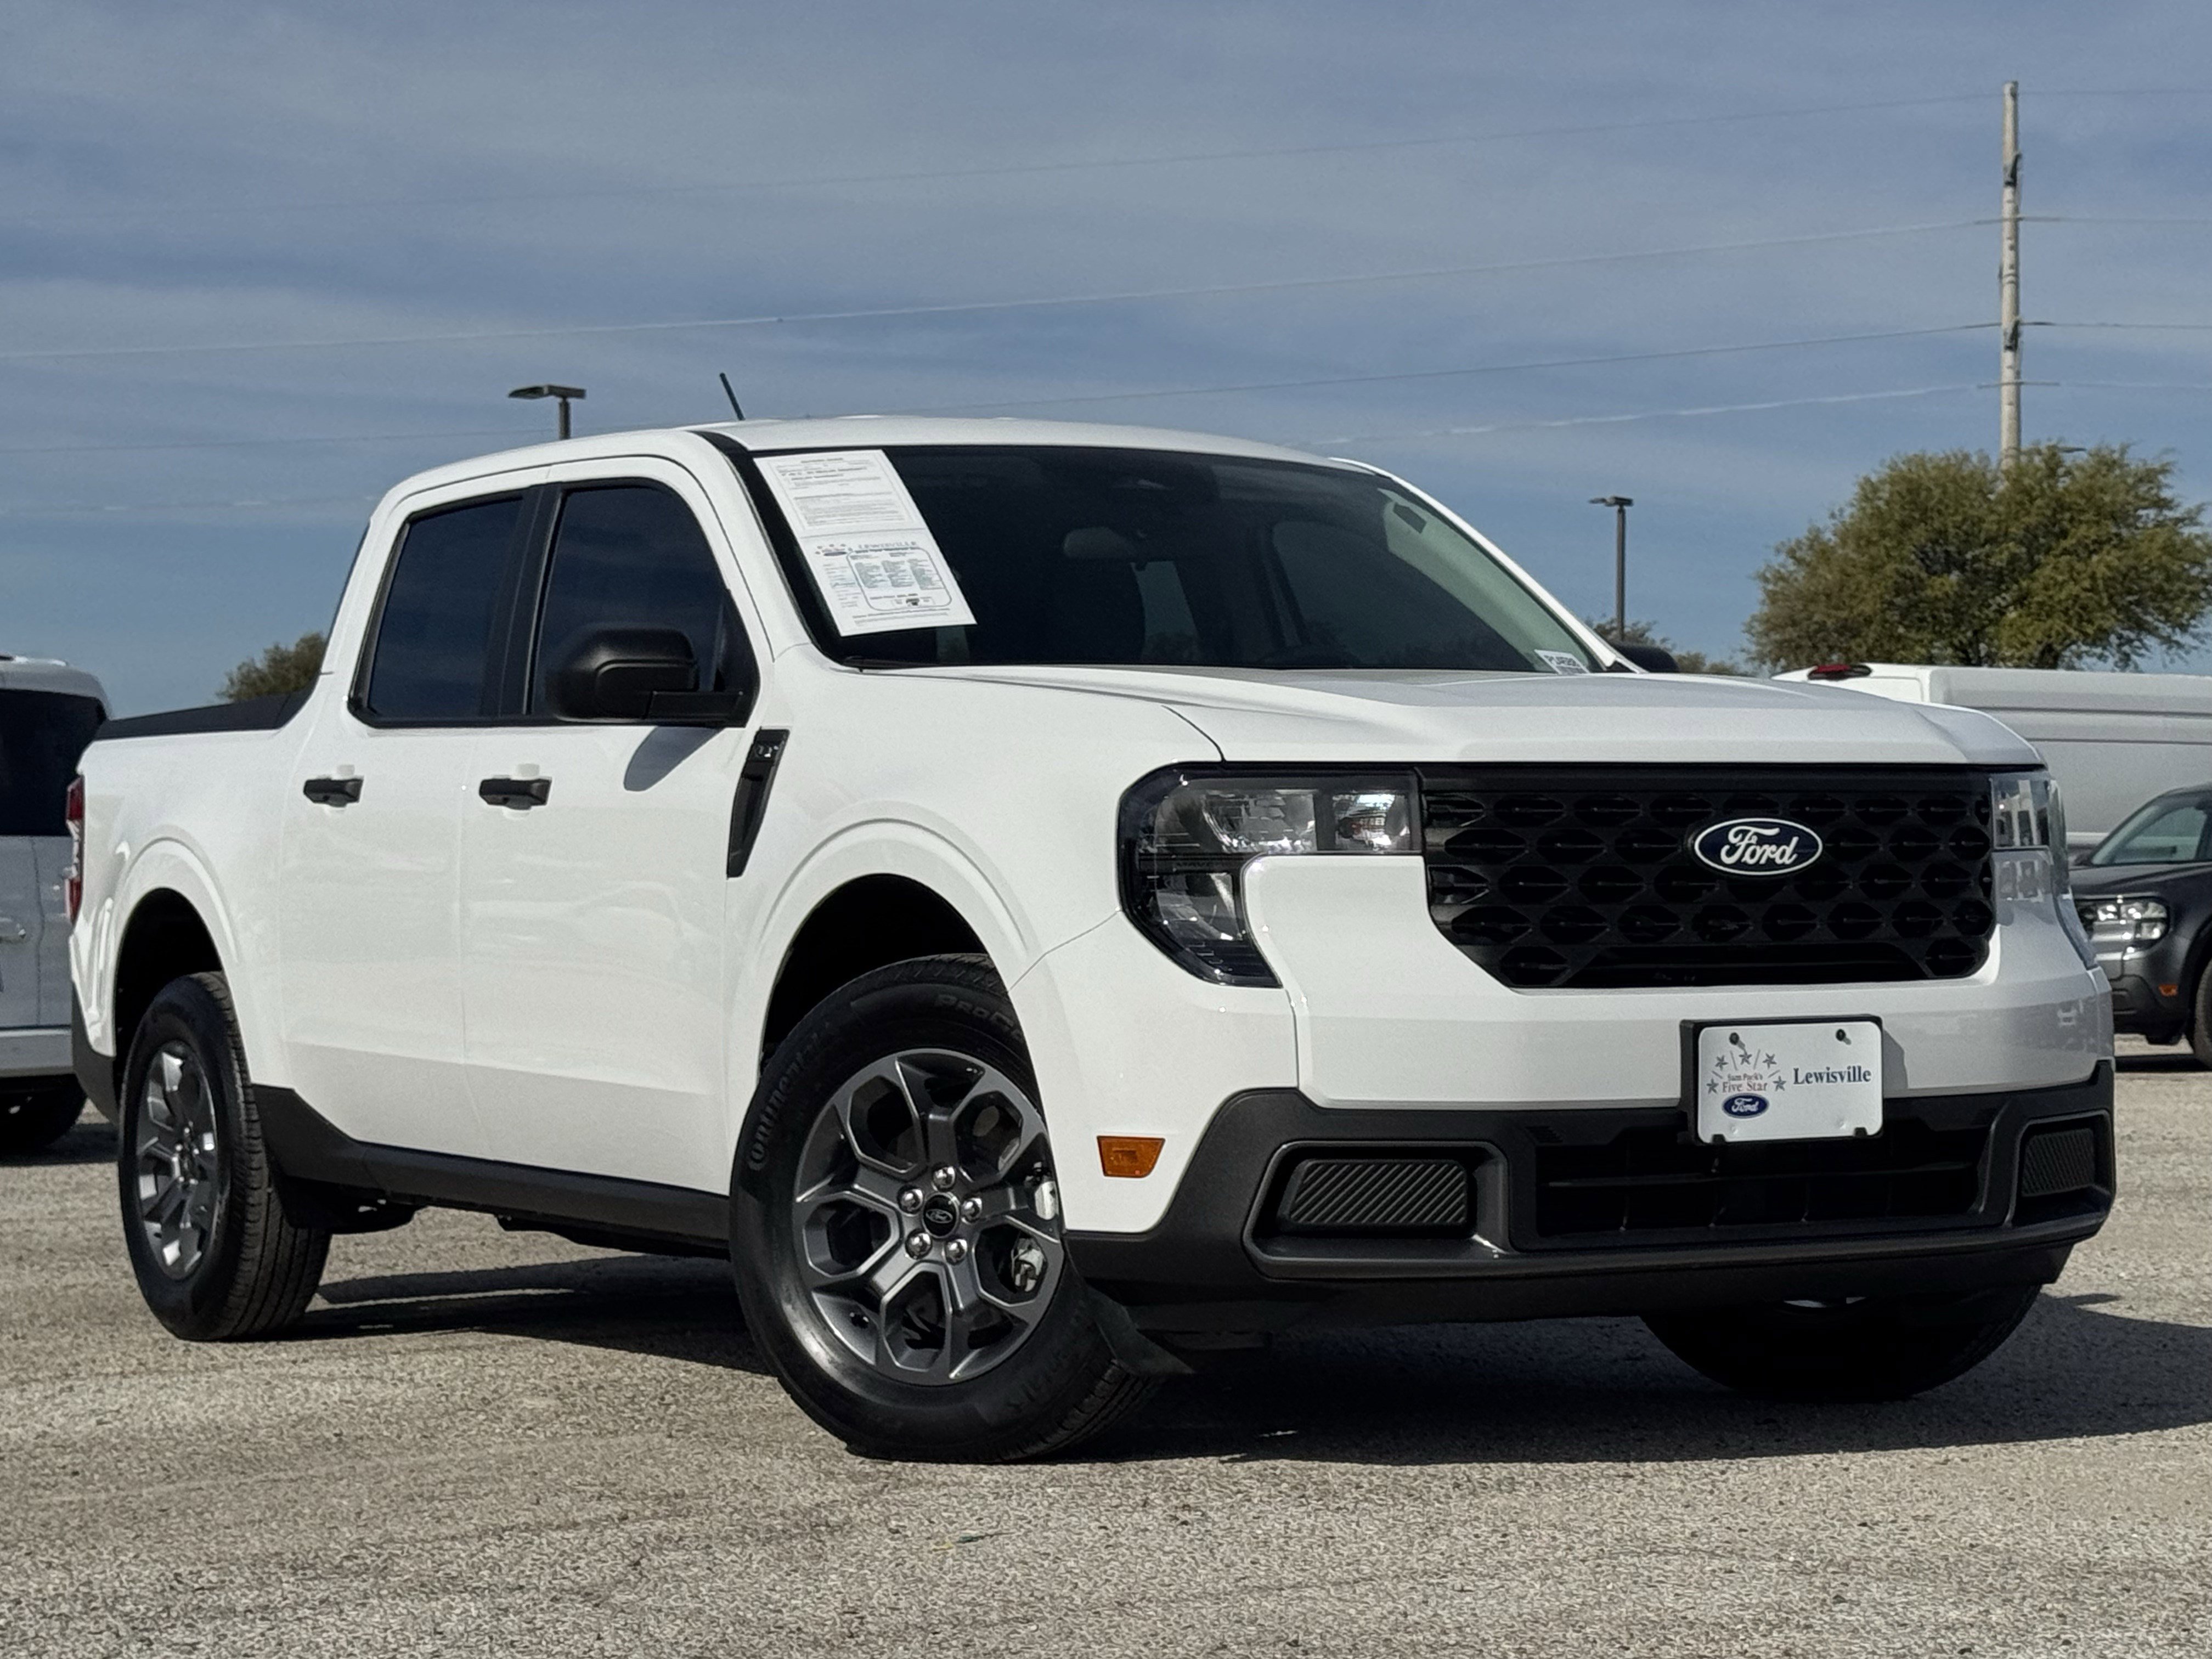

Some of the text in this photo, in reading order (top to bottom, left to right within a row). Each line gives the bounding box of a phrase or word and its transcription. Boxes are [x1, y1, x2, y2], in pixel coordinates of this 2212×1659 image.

[1720, 825, 1799, 865] Ford
[1793, 1065, 1871, 1085] Lewisville
[1723, 1080, 1768, 1093] Five Star
[1731, 1097, 1760, 1113] Ford
